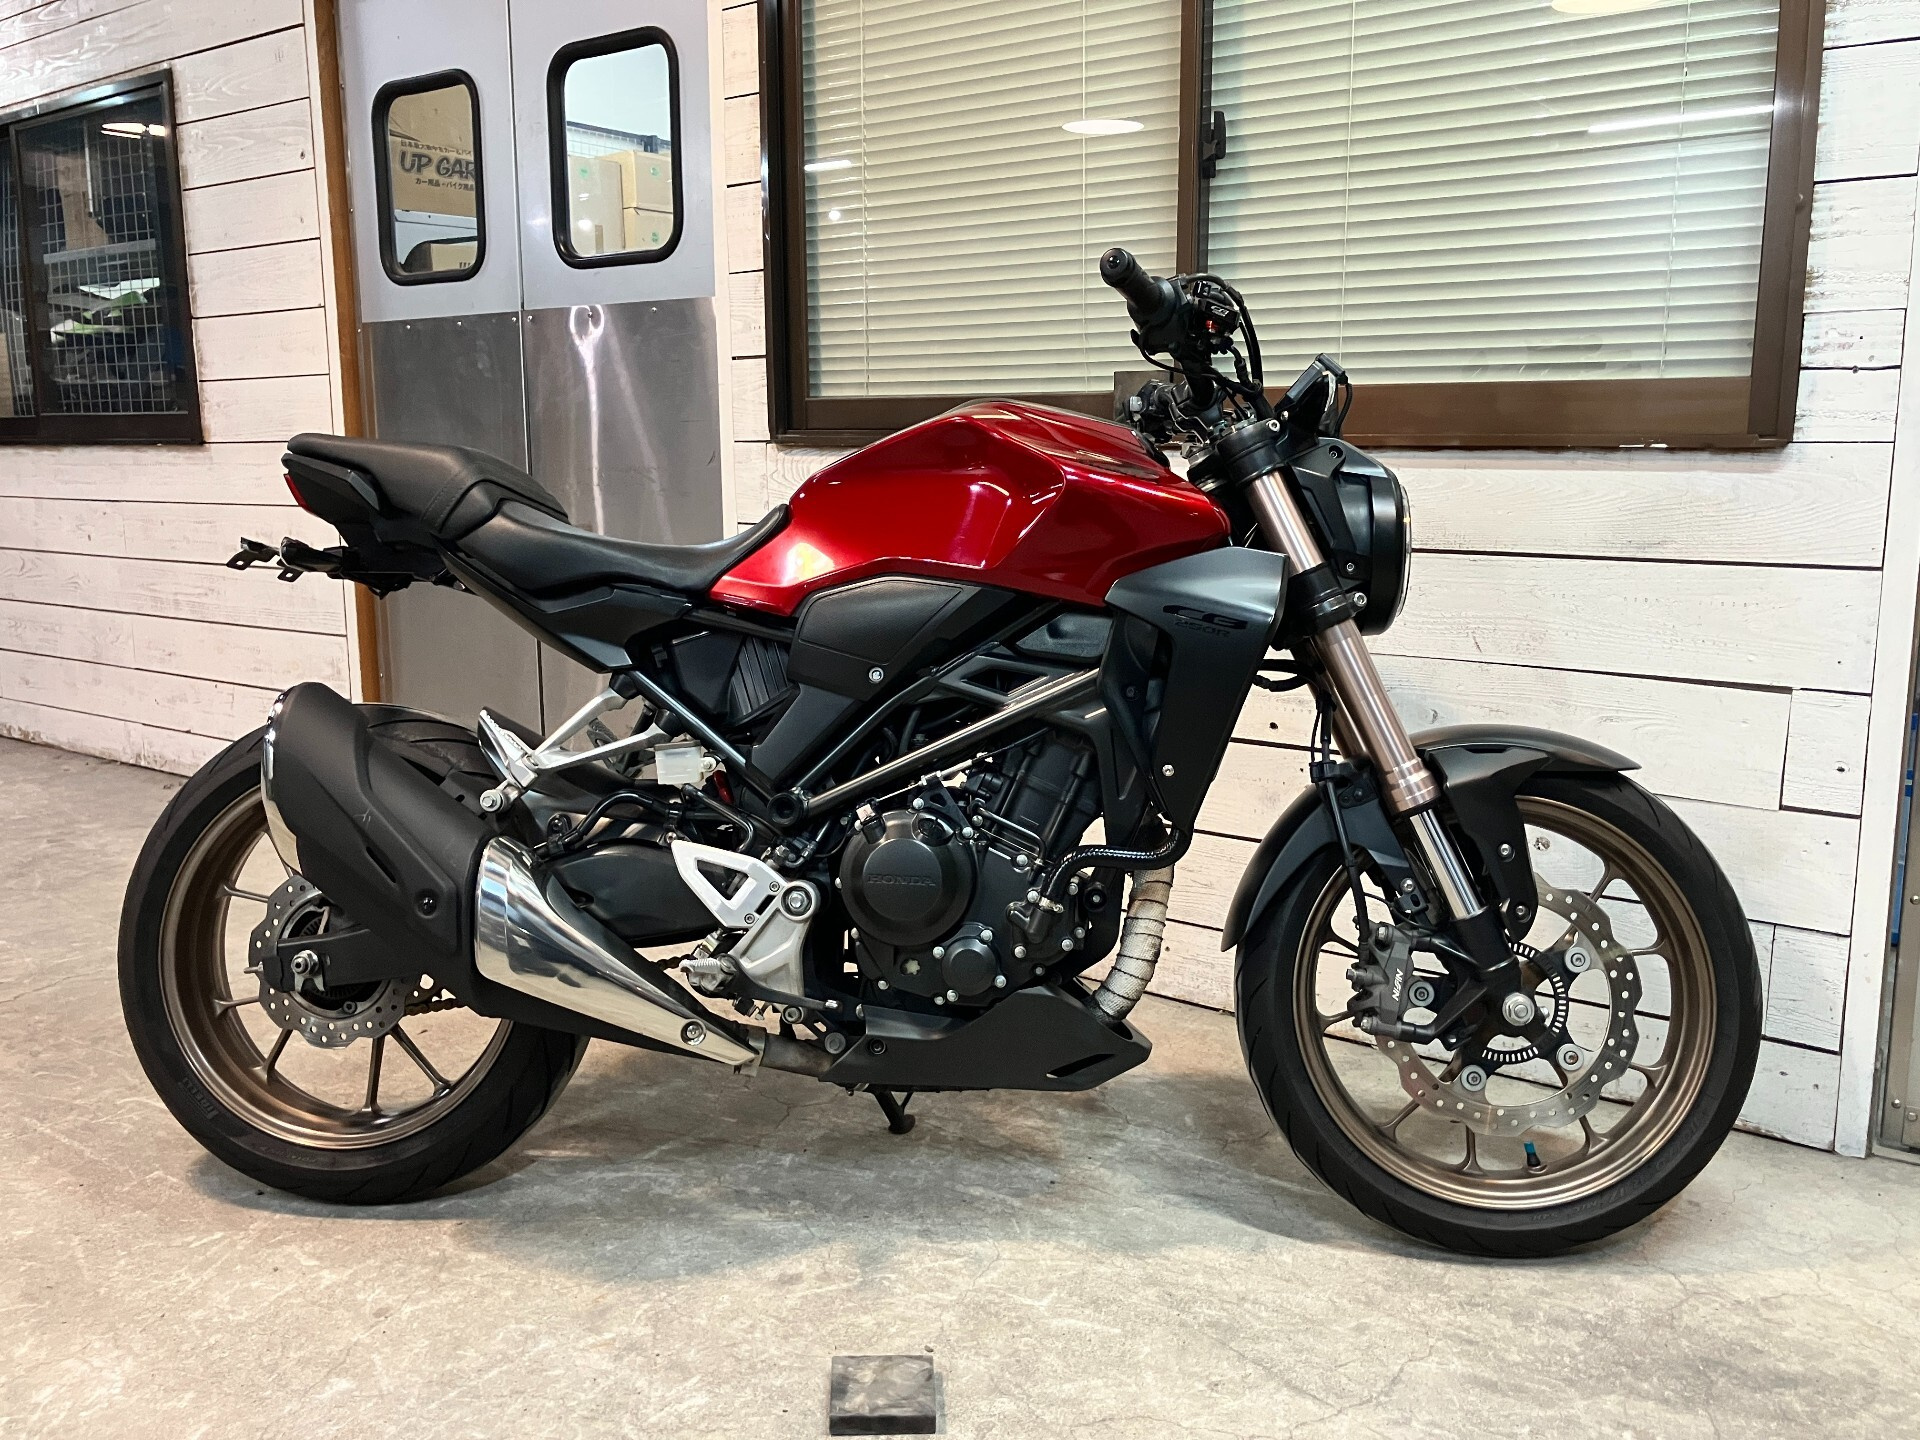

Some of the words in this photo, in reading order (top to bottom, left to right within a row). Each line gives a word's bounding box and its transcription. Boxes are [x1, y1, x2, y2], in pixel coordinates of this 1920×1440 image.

[400, 150, 432, 174] UP
[437, 156, 475, 180] GAR
[867, 873, 936, 887] HONDA
